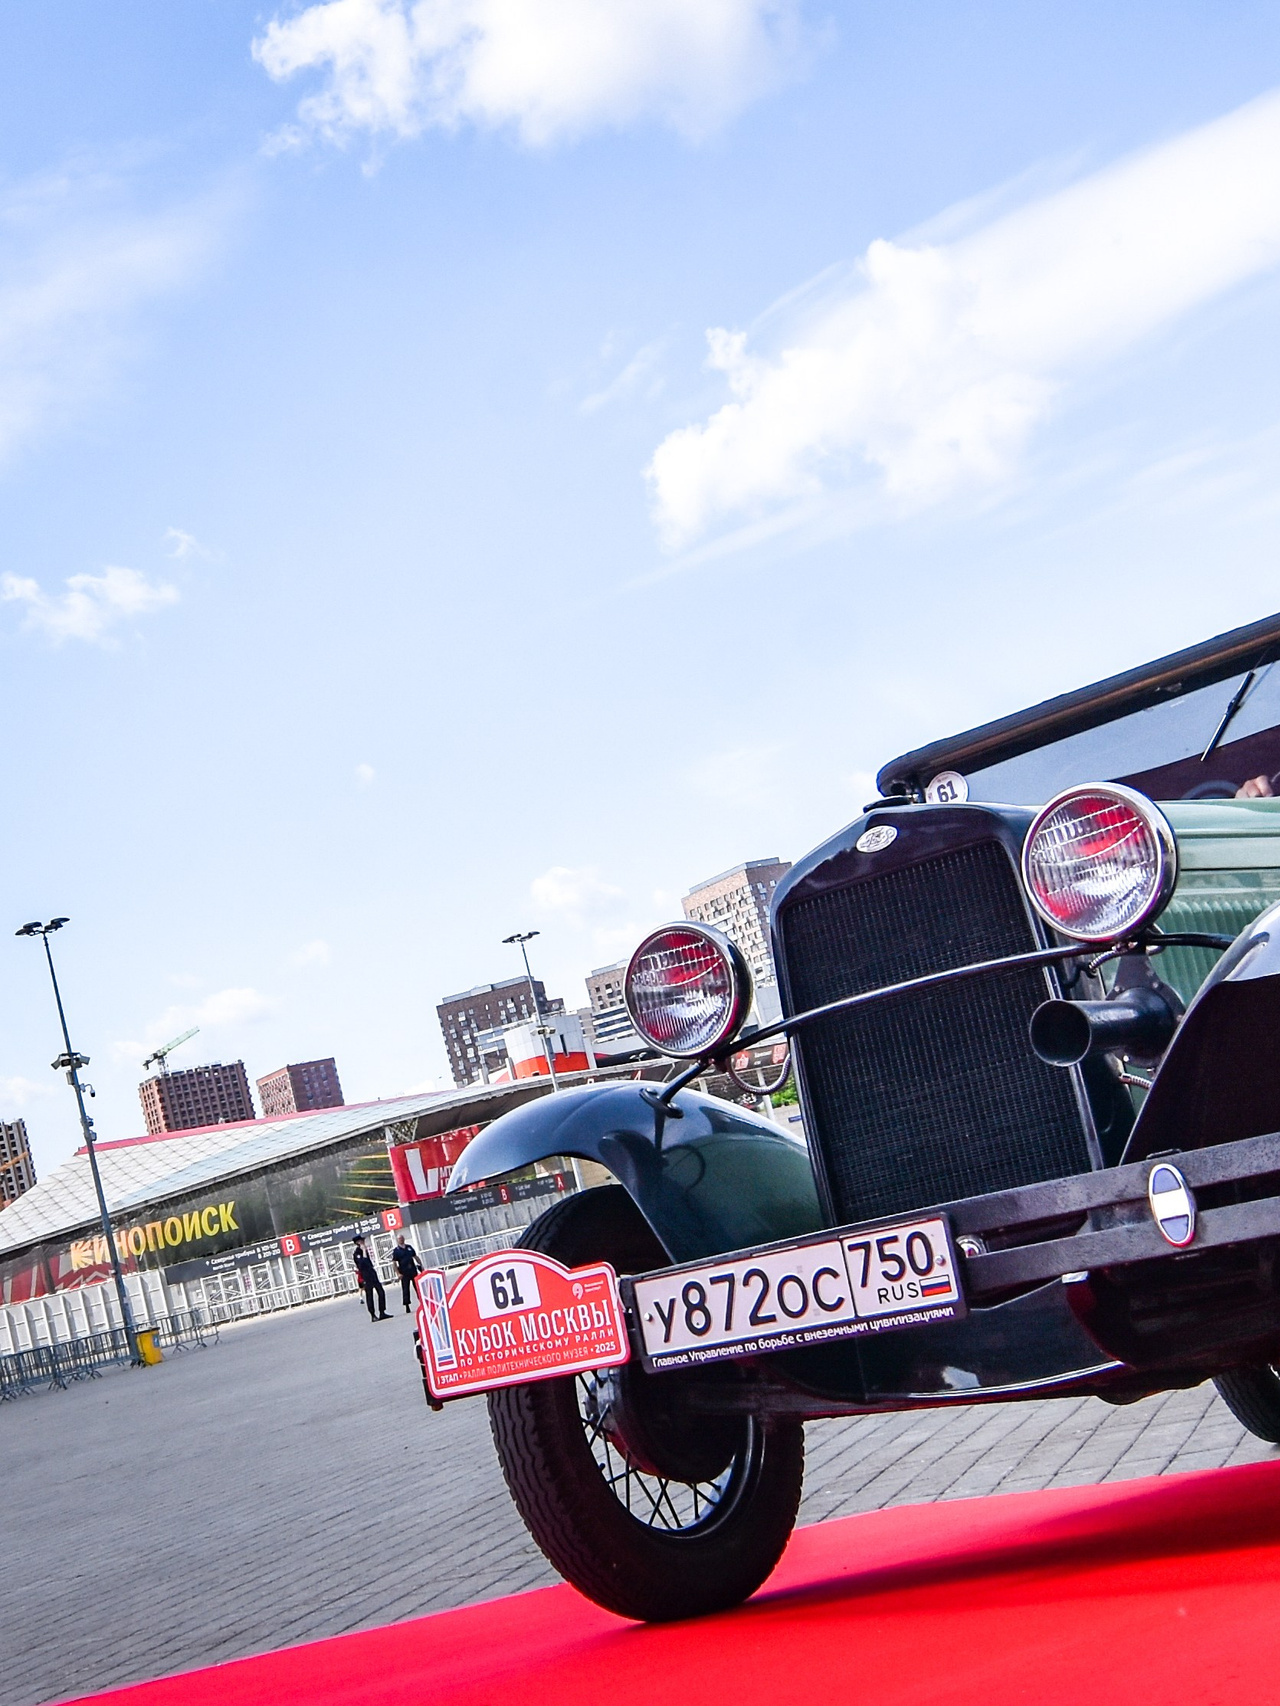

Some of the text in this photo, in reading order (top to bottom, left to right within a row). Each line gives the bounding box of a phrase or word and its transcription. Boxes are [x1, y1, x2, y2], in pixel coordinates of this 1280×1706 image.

[937, 780, 958, 802] 61
[70, 1201, 239, 1271] КИНОПОИСК
[490, 1268, 524, 1310] 61
[653, 1230, 934, 1344] У872ОС 750
[877, 1281, 920, 1304] RUS
[455, 1299, 613, 1357] КУБОК МОСКВЫ
[460, 1328, 614, 1368] ПО ИСТОРИЧЕСКОМУ РАЛЛИ
[652, 1306, 954, 1369] Главное Управление по борьбе с внеземными цивилизациями
[441, 1373, 459, 1386] ЭТАП
[463, 1368, 486, 1380] РАЛЛИ
[486, 1351, 561, 1377] ПОЛИТЕХНИЧЕСКОГО
[562, 1346, 589, 1361] МУЗЕЯ
[595, 1341, 616, 1354] 2025
